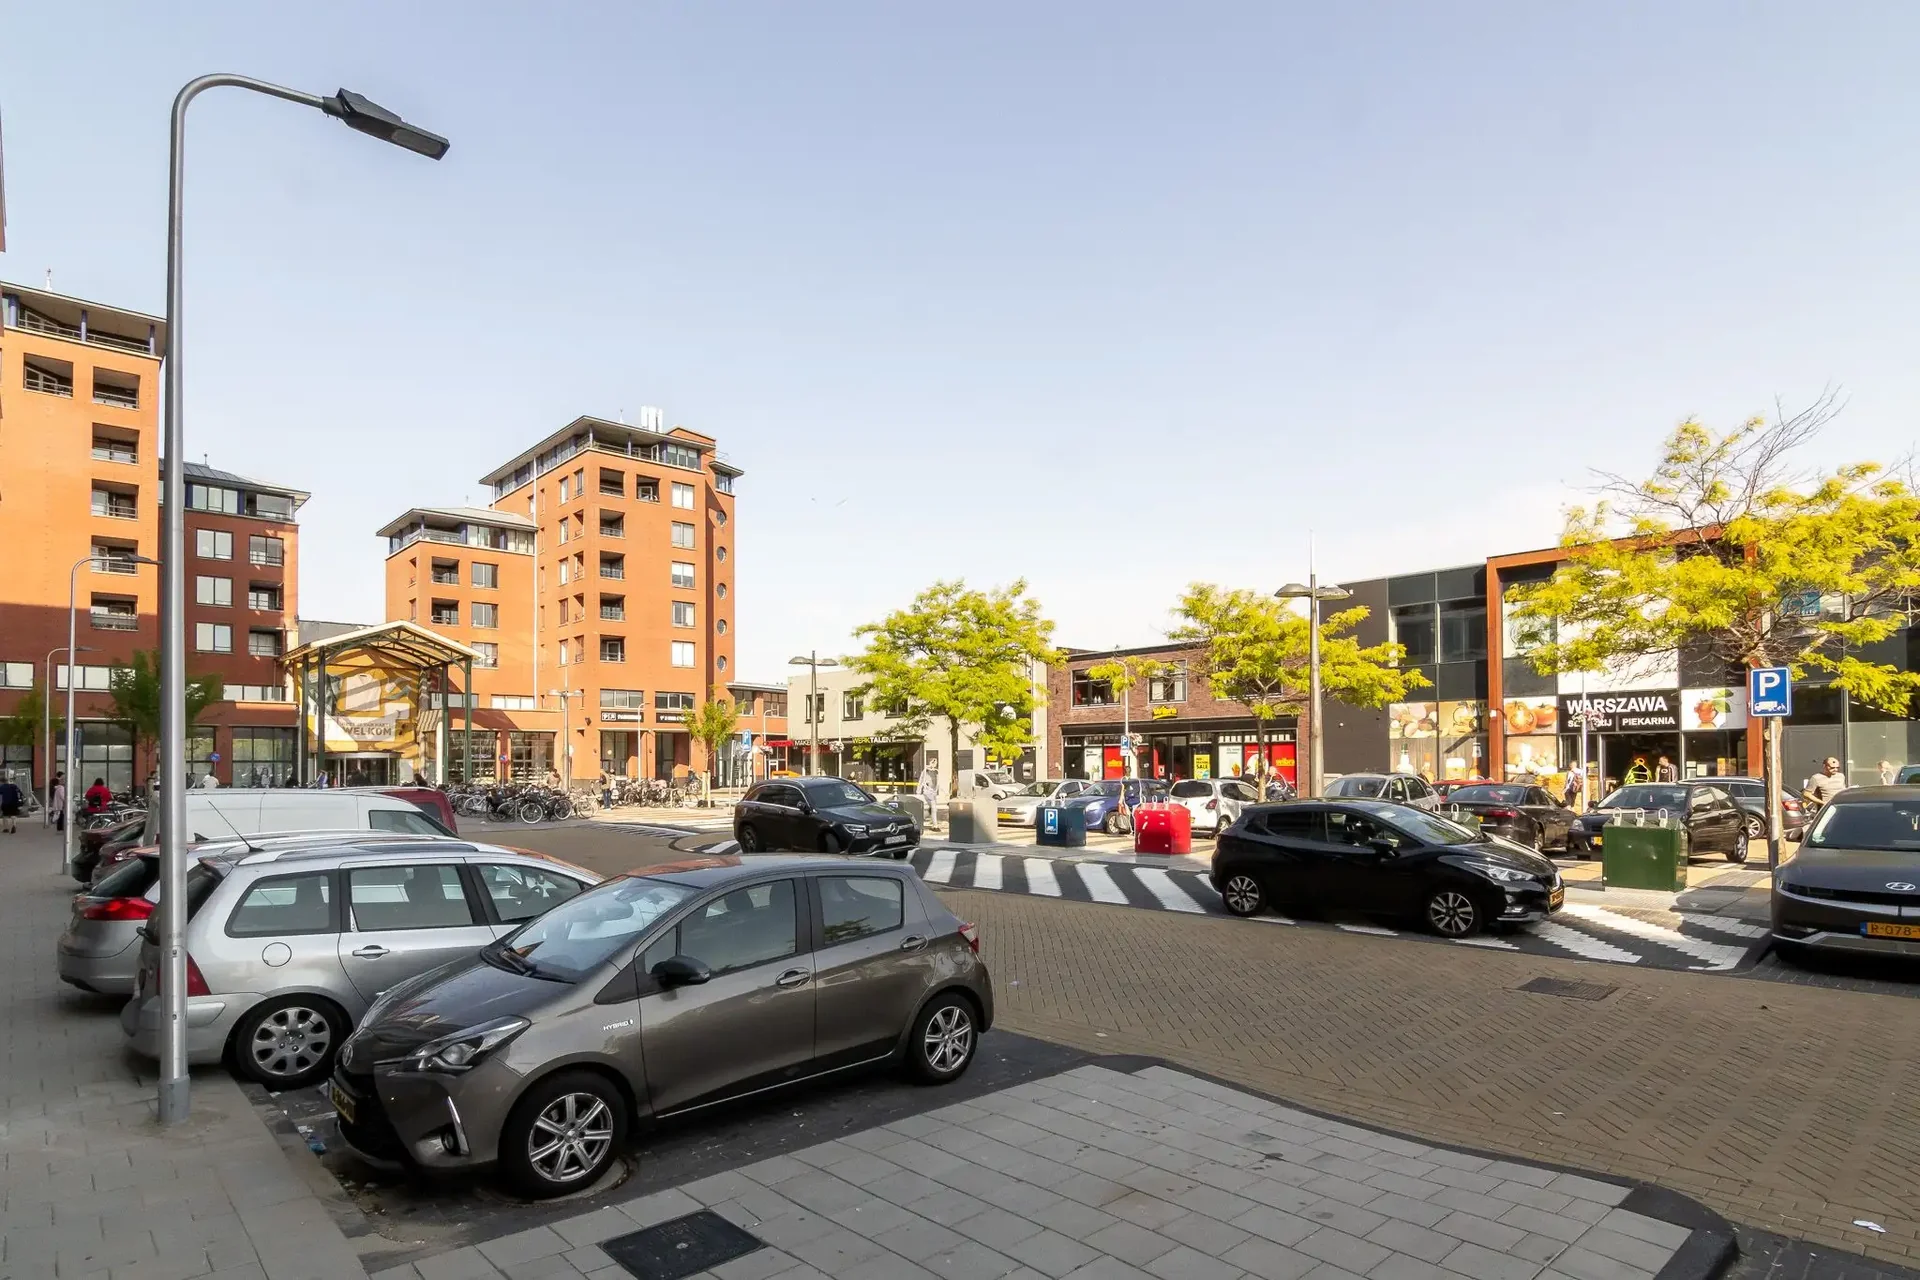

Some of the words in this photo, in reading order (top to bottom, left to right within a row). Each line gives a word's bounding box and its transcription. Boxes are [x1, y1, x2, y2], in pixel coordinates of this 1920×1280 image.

[1760, 672, 1780, 697] P
[1566, 696, 1668, 714] WARSZAWA
[1622, 716, 1675, 726] PIEKARNIA
[343, 727, 392, 736] WELKOM
[1048, 811, 1054, 824] P
[1871, 923, 1920, 936] R-078-
